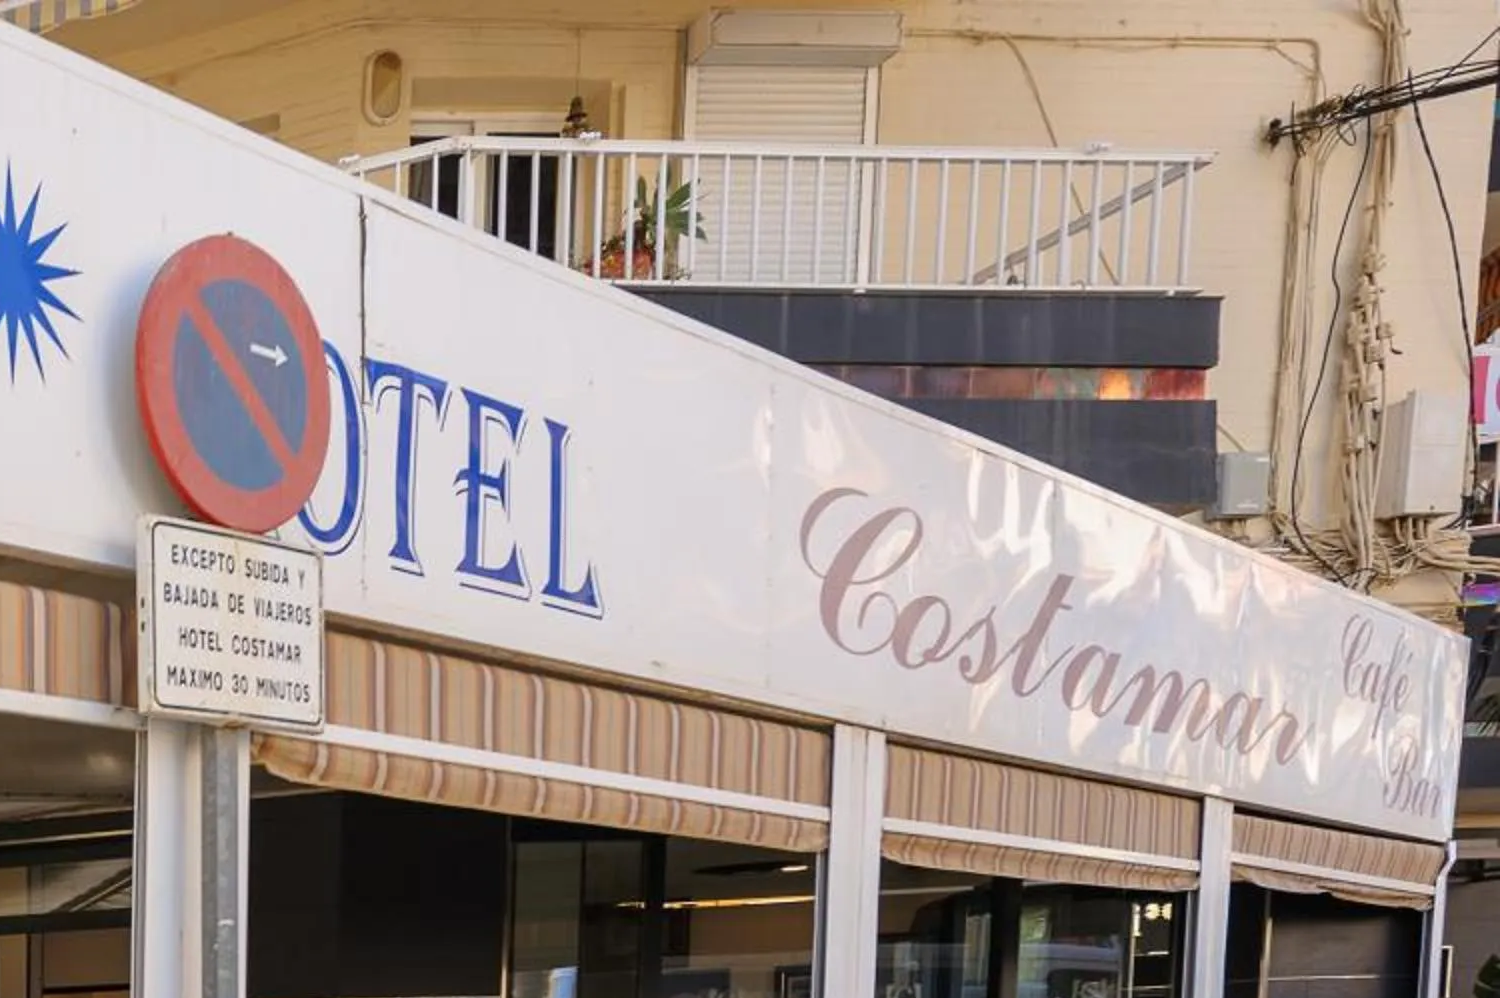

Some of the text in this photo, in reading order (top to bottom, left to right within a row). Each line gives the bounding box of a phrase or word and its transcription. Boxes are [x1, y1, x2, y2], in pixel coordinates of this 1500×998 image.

[171, 544, 306, 591] EXCEPTO SUBIDA Y
[298, 338, 1315, 765] OTEL Costamar
[163, 582, 312, 625] BAJADA DE VIAJEROS
[179, 626, 301, 663] HOTEL COSTAMAR
[167, 665, 310, 703] MAXIMO 30 MINUTOS
[1342, 613, 1413, 740] Café
[1384, 735, 1443, 819] Bar
